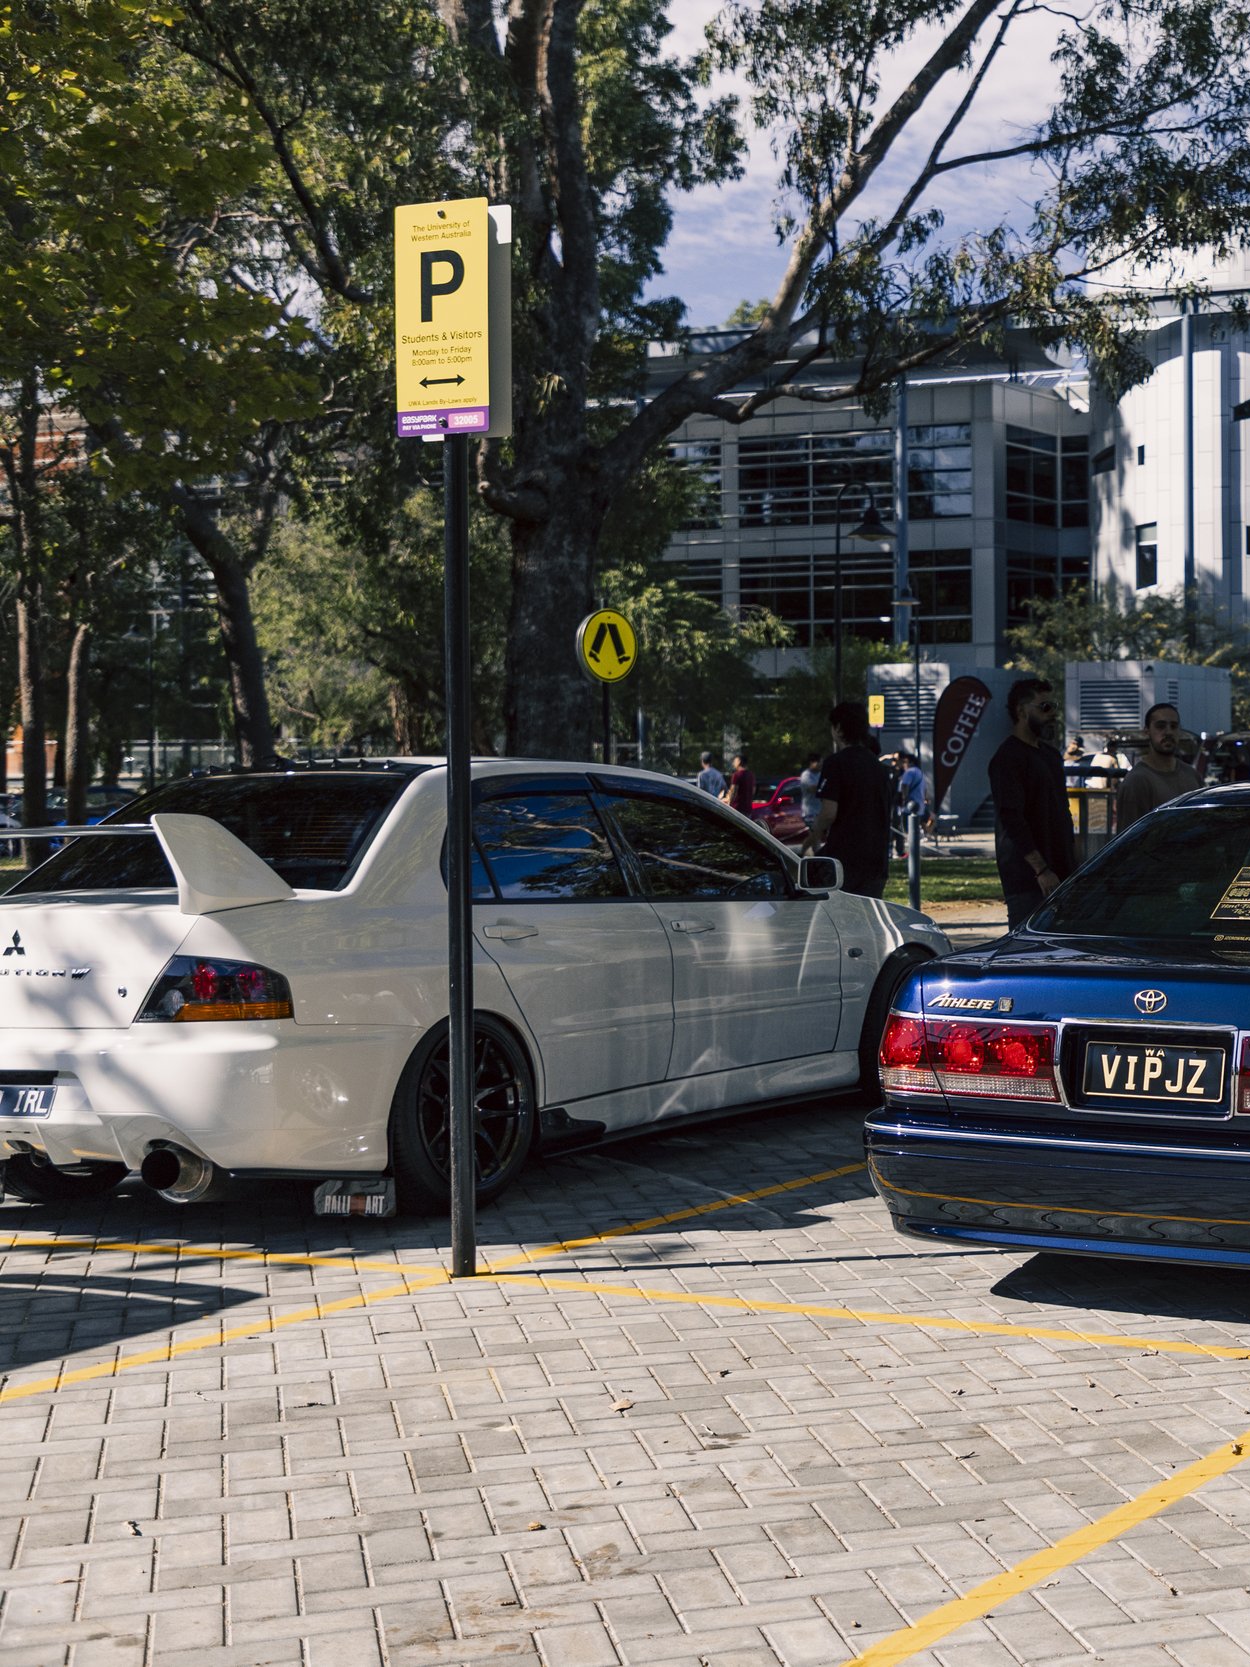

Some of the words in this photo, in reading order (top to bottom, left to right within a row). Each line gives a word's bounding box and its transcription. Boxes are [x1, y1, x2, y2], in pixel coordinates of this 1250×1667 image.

[427, 221, 461, 231] University
[463, 220, 470, 228] of
[411, 234, 440, 242] Western
[441, 230, 472, 239] Australia
[421, 250, 464, 322] P
[401, 334, 440, 345] Students
[441, 332, 447, 341] &
[450, 330, 482, 340] Visitors
[412, 348, 440, 357] Monday
[450, 345, 472, 354] Friday
[412, 358, 437, 367] 8:00am
[447, 355, 473, 364] 5:00pm
[941, 693, 986, 767] COFFEE
[927, 992, 996, 1010] ATHLETE
[1144, 1048, 1165, 1057] WA
[1101, 1054, 1208, 1095] VIPJZ
[13, 1090, 48, 1113] IRL
[324, 1195, 351, 1214] RALLI
[365, 1195, 385, 1214] ART
